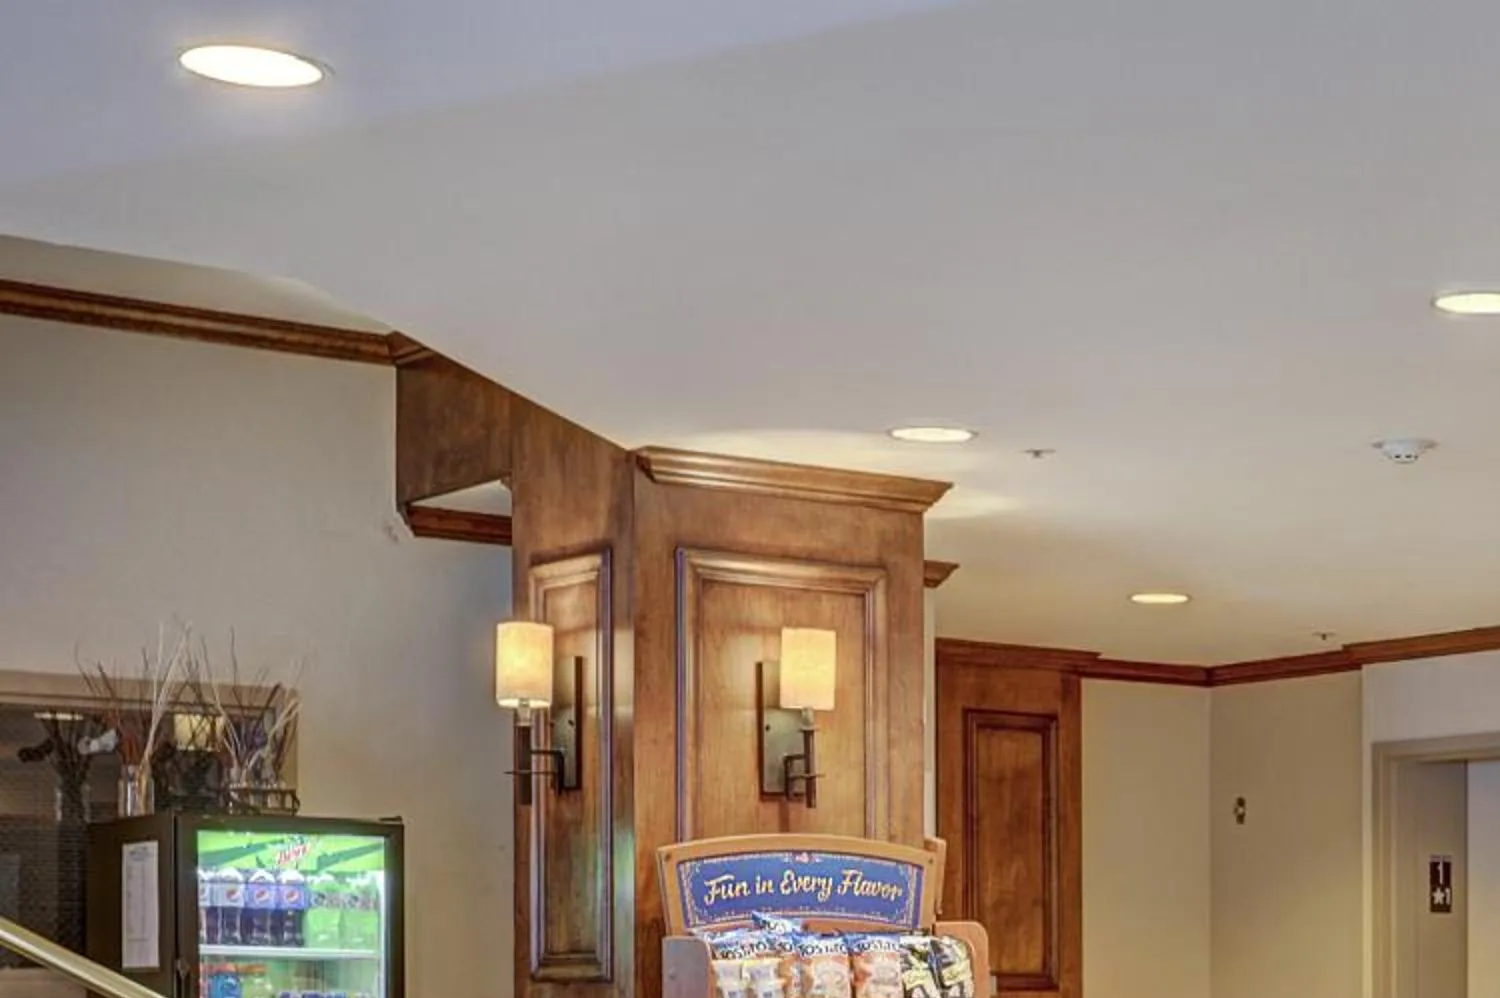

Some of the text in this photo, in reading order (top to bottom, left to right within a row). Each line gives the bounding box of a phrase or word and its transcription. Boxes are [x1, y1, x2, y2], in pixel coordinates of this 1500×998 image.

[704, 868, 903, 905] Fun in Every Flavor
